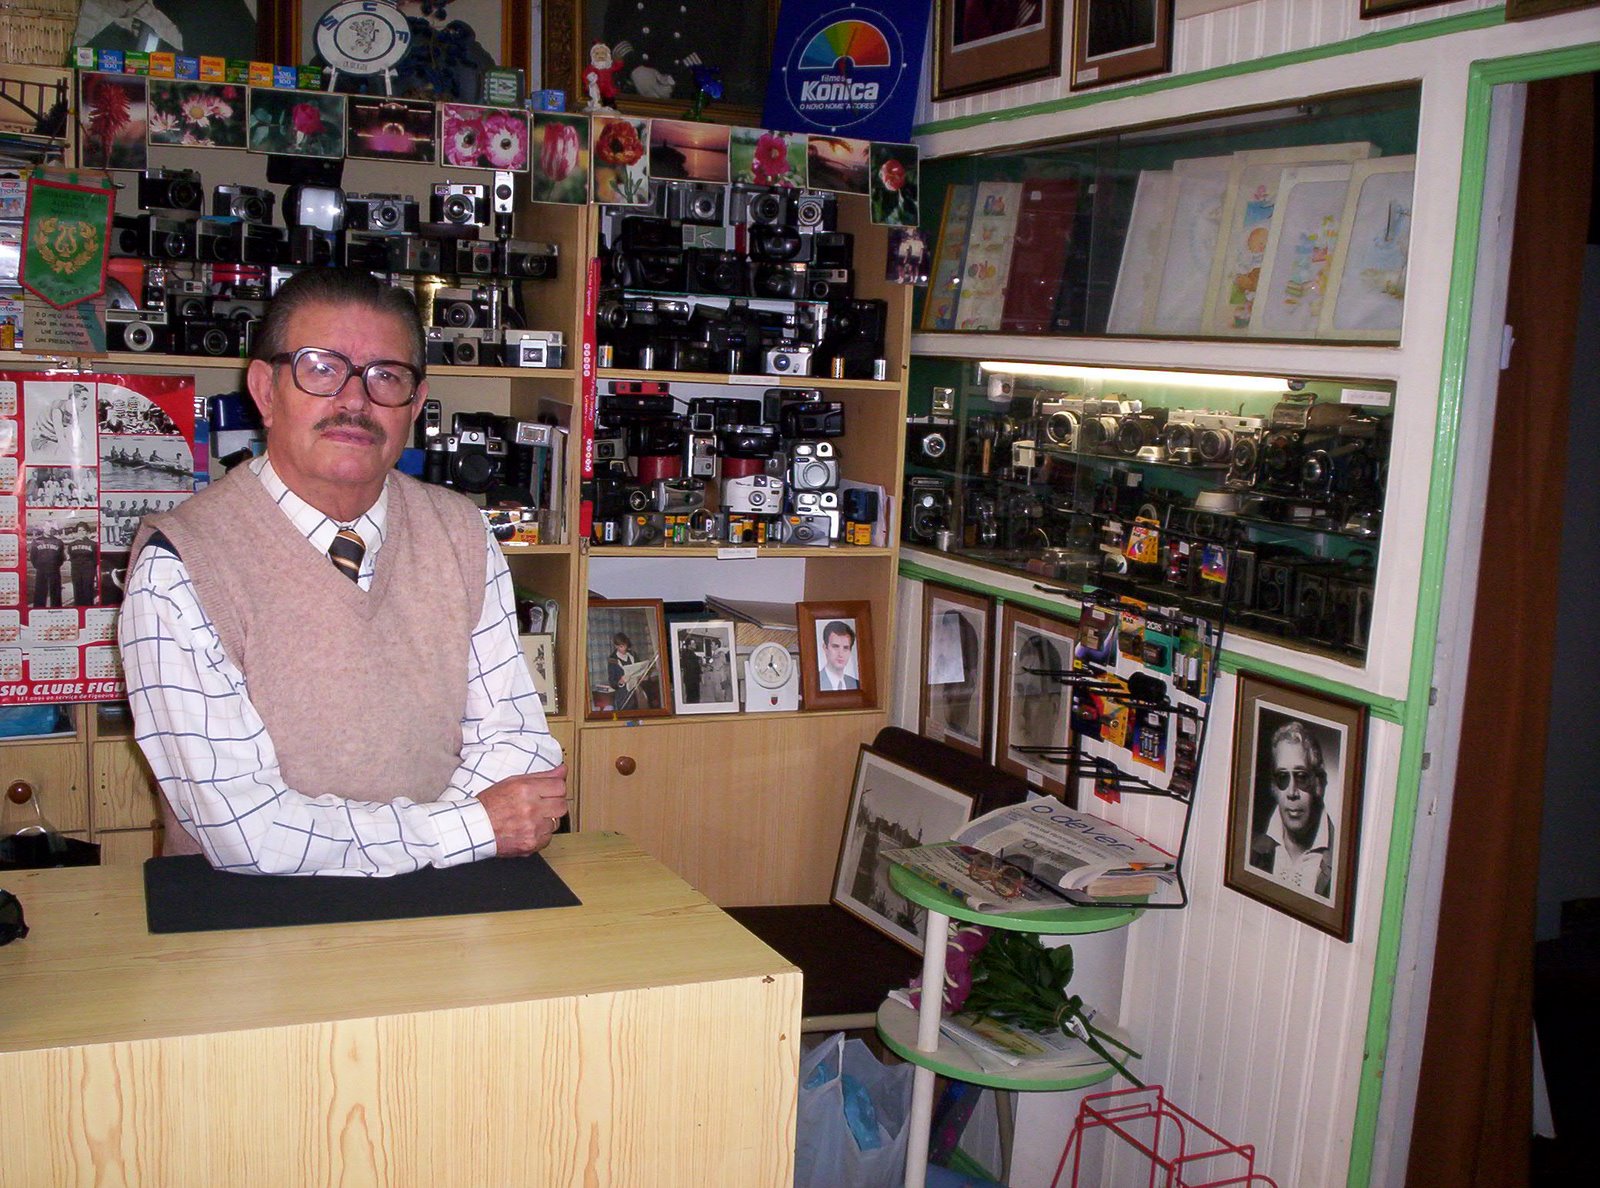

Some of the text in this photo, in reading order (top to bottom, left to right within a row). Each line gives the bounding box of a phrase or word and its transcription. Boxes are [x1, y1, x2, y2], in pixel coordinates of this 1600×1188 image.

[801, 78, 880, 101] Konica
[33, 683, 85, 695] CLUBE
[1031, 805, 1054, 814] O
[1050, 815, 1135, 851] dever
